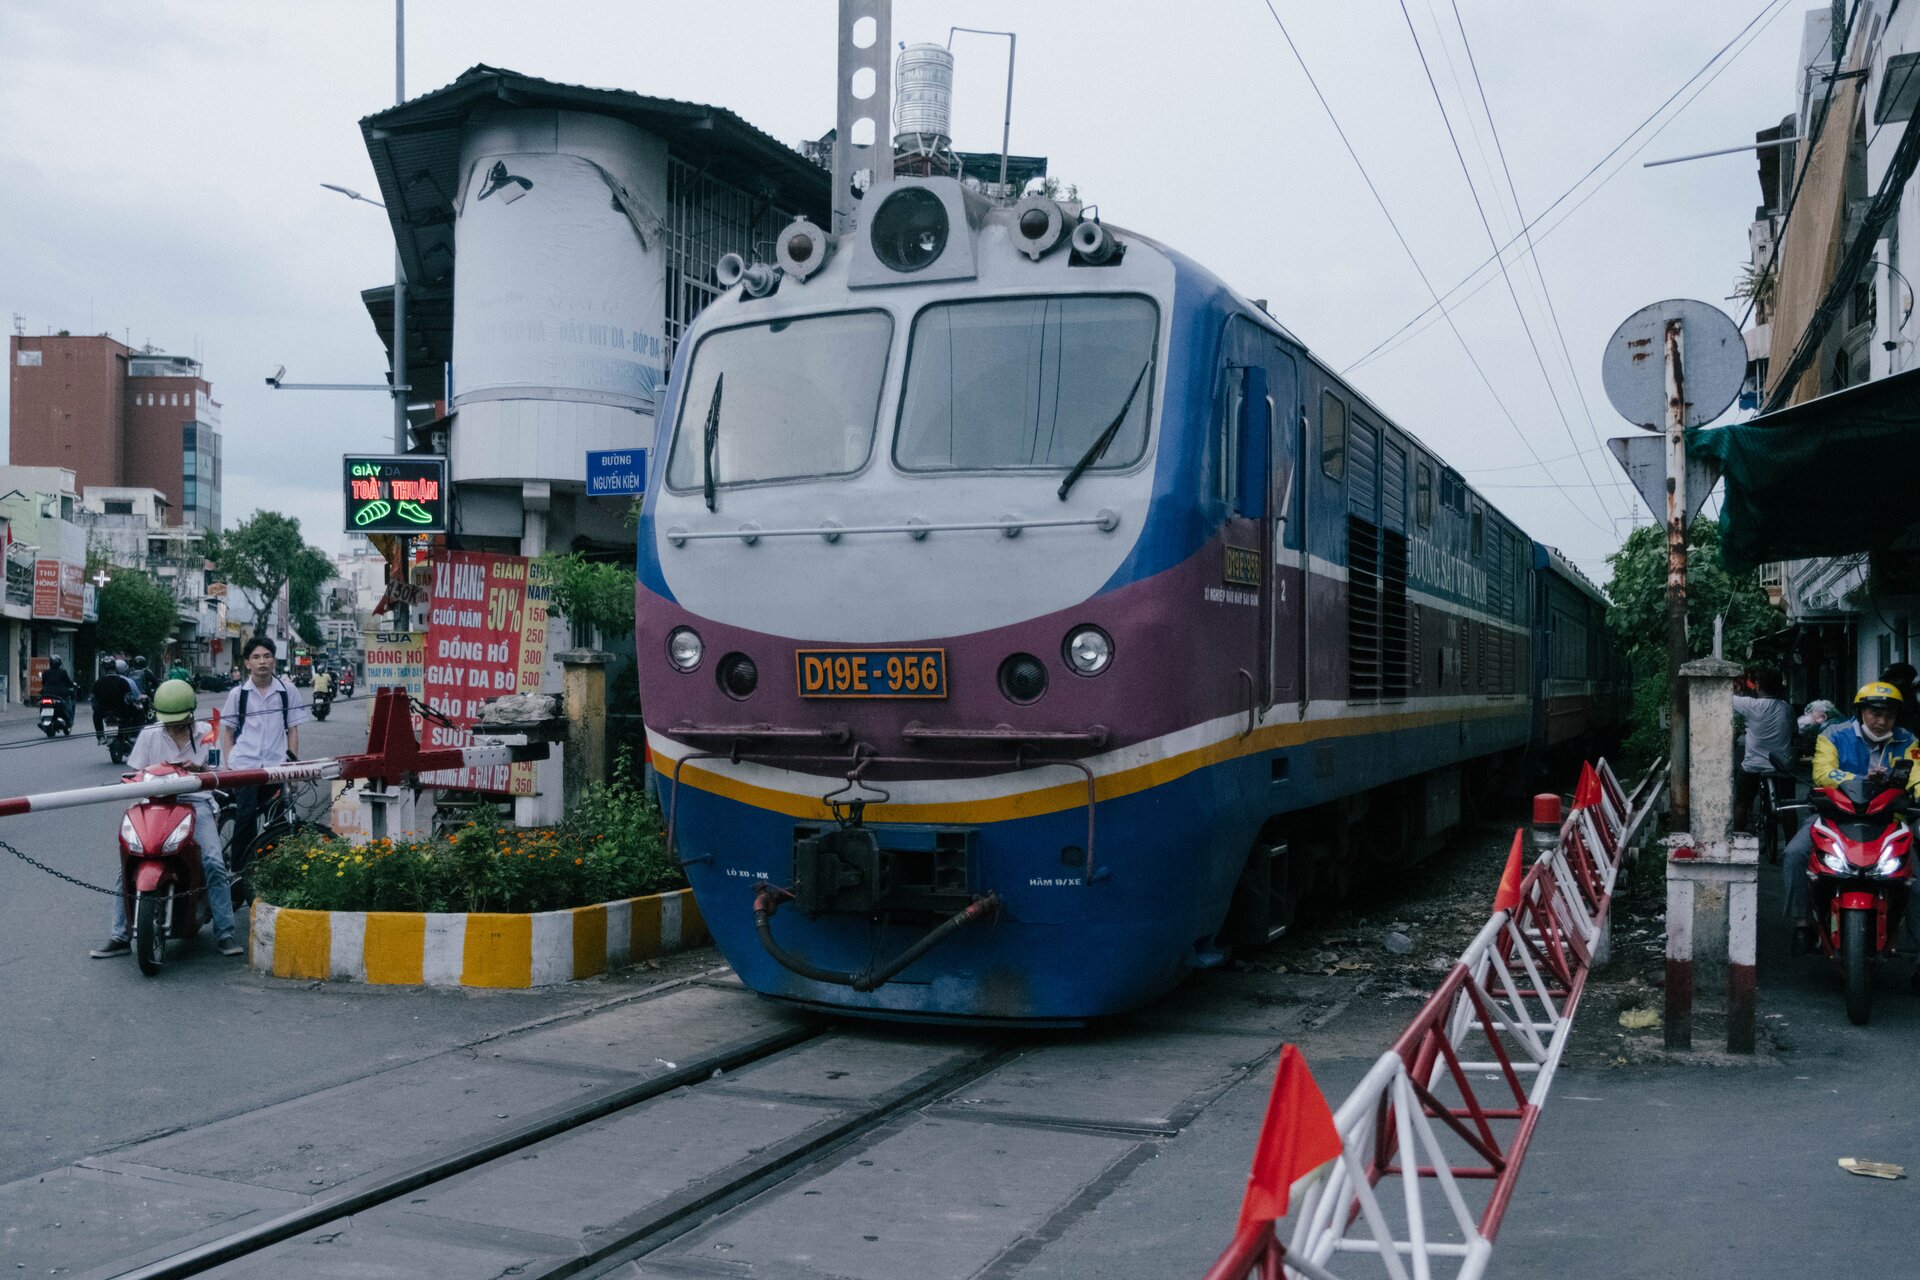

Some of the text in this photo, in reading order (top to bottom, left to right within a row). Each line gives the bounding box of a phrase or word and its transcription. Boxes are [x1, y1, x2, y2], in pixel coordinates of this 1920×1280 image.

[612, 326, 625, 349] DA
[633, 328, 649, 354] BÓP
[352, 463, 401, 477] GIÀY DA
[602, 453, 632, 466] ĐƯỜNG
[352, 477, 438, 504] TOÀN THUẬN
[593, 471, 640, 492] NGUYỄN KIỆM
[435, 550, 486, 601] XẢ HÀNG
[493, 558, 525, 580] GIẢM
[1281, 579, 1286, 601] 2
[433, 604, 482, 629] CUỐI NĂM
[487, 588, 521, 632] 50%
[528, 607, 546, 622] 150
[526, 628, 544, 643] 250
[439, 634, 509, 663] ĐỒNG HỒ
[524, 650, 542, 665] 300
[428, 663, 516, 691] GIÀY DA BÒ
[521, 671, 540, 687] 500
[429, 691, 462, 718] BẢO
[515, 778, 532, 793] 350
